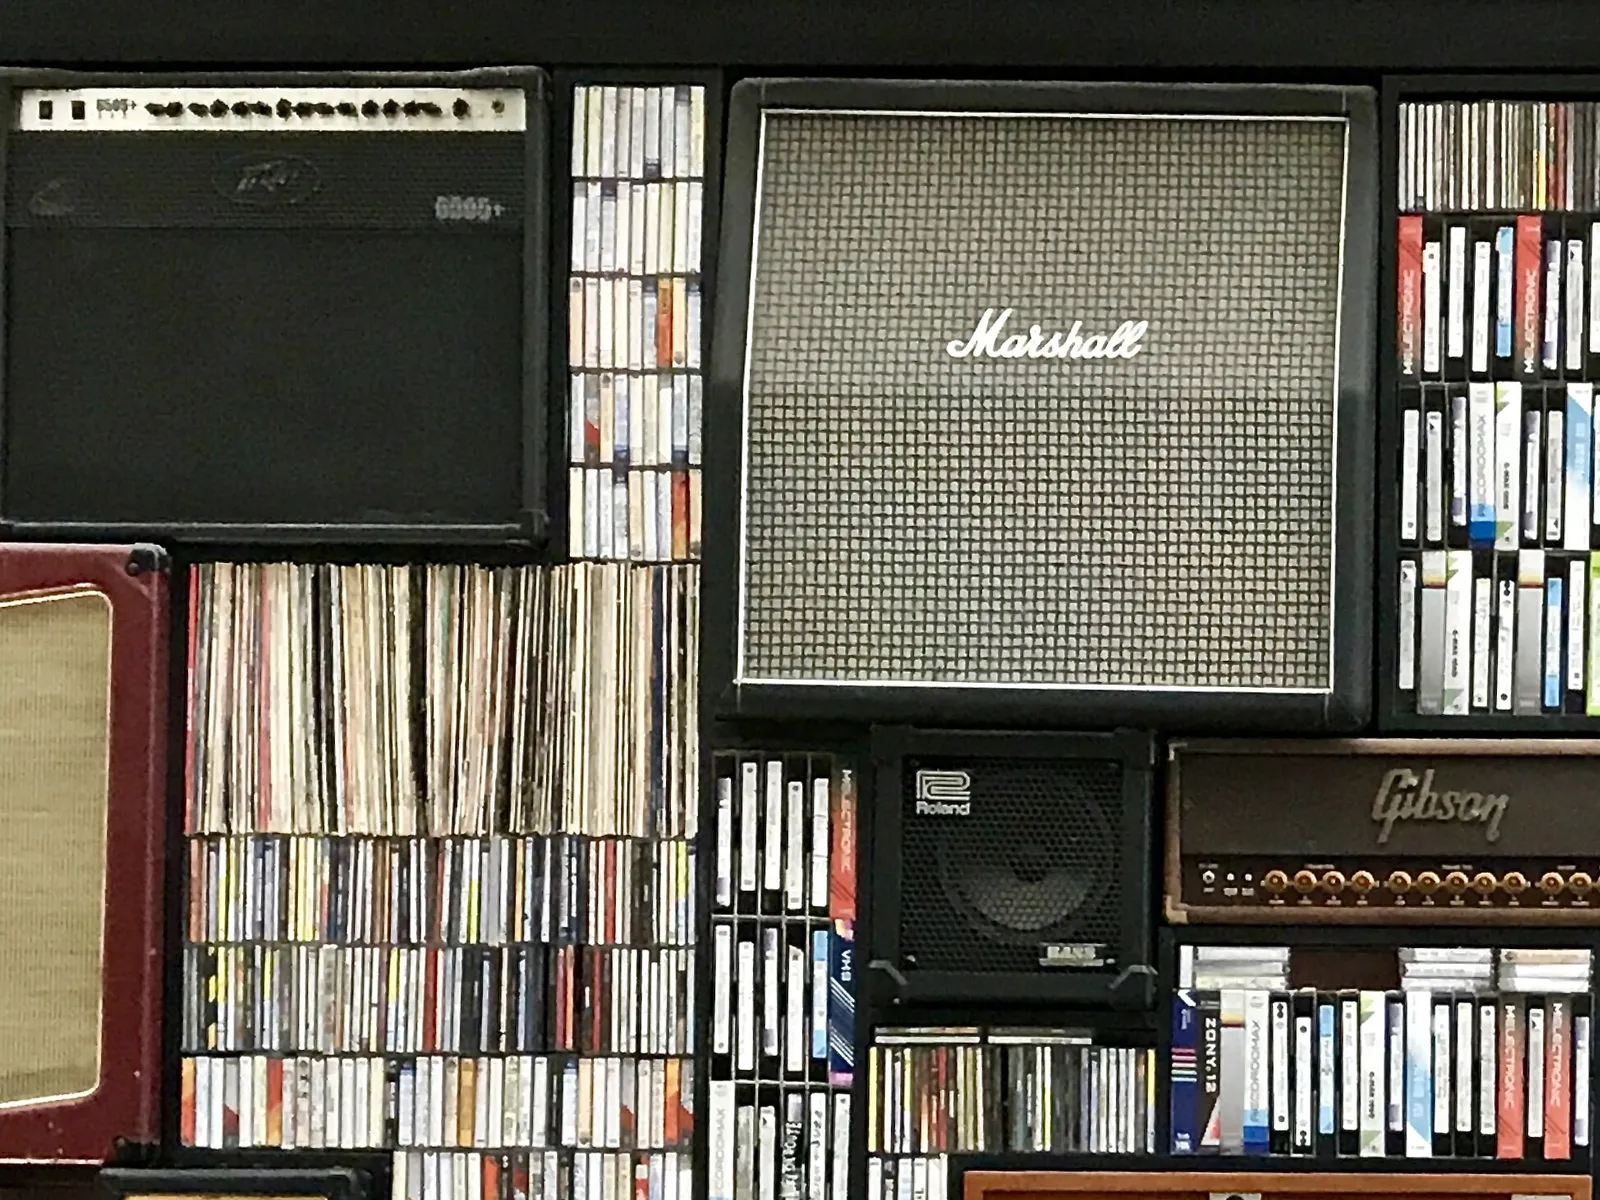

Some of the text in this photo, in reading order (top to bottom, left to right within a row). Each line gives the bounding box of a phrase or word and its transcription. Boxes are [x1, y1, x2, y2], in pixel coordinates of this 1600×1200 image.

[946, 307, 1149, 359] Marshall
[916, 801, 970, 815] Roland
[1372, 768, 1510, 844] Gibson
[840, 948, 852, 982] VHS
[1047, 946, 1097, 960] BASS
